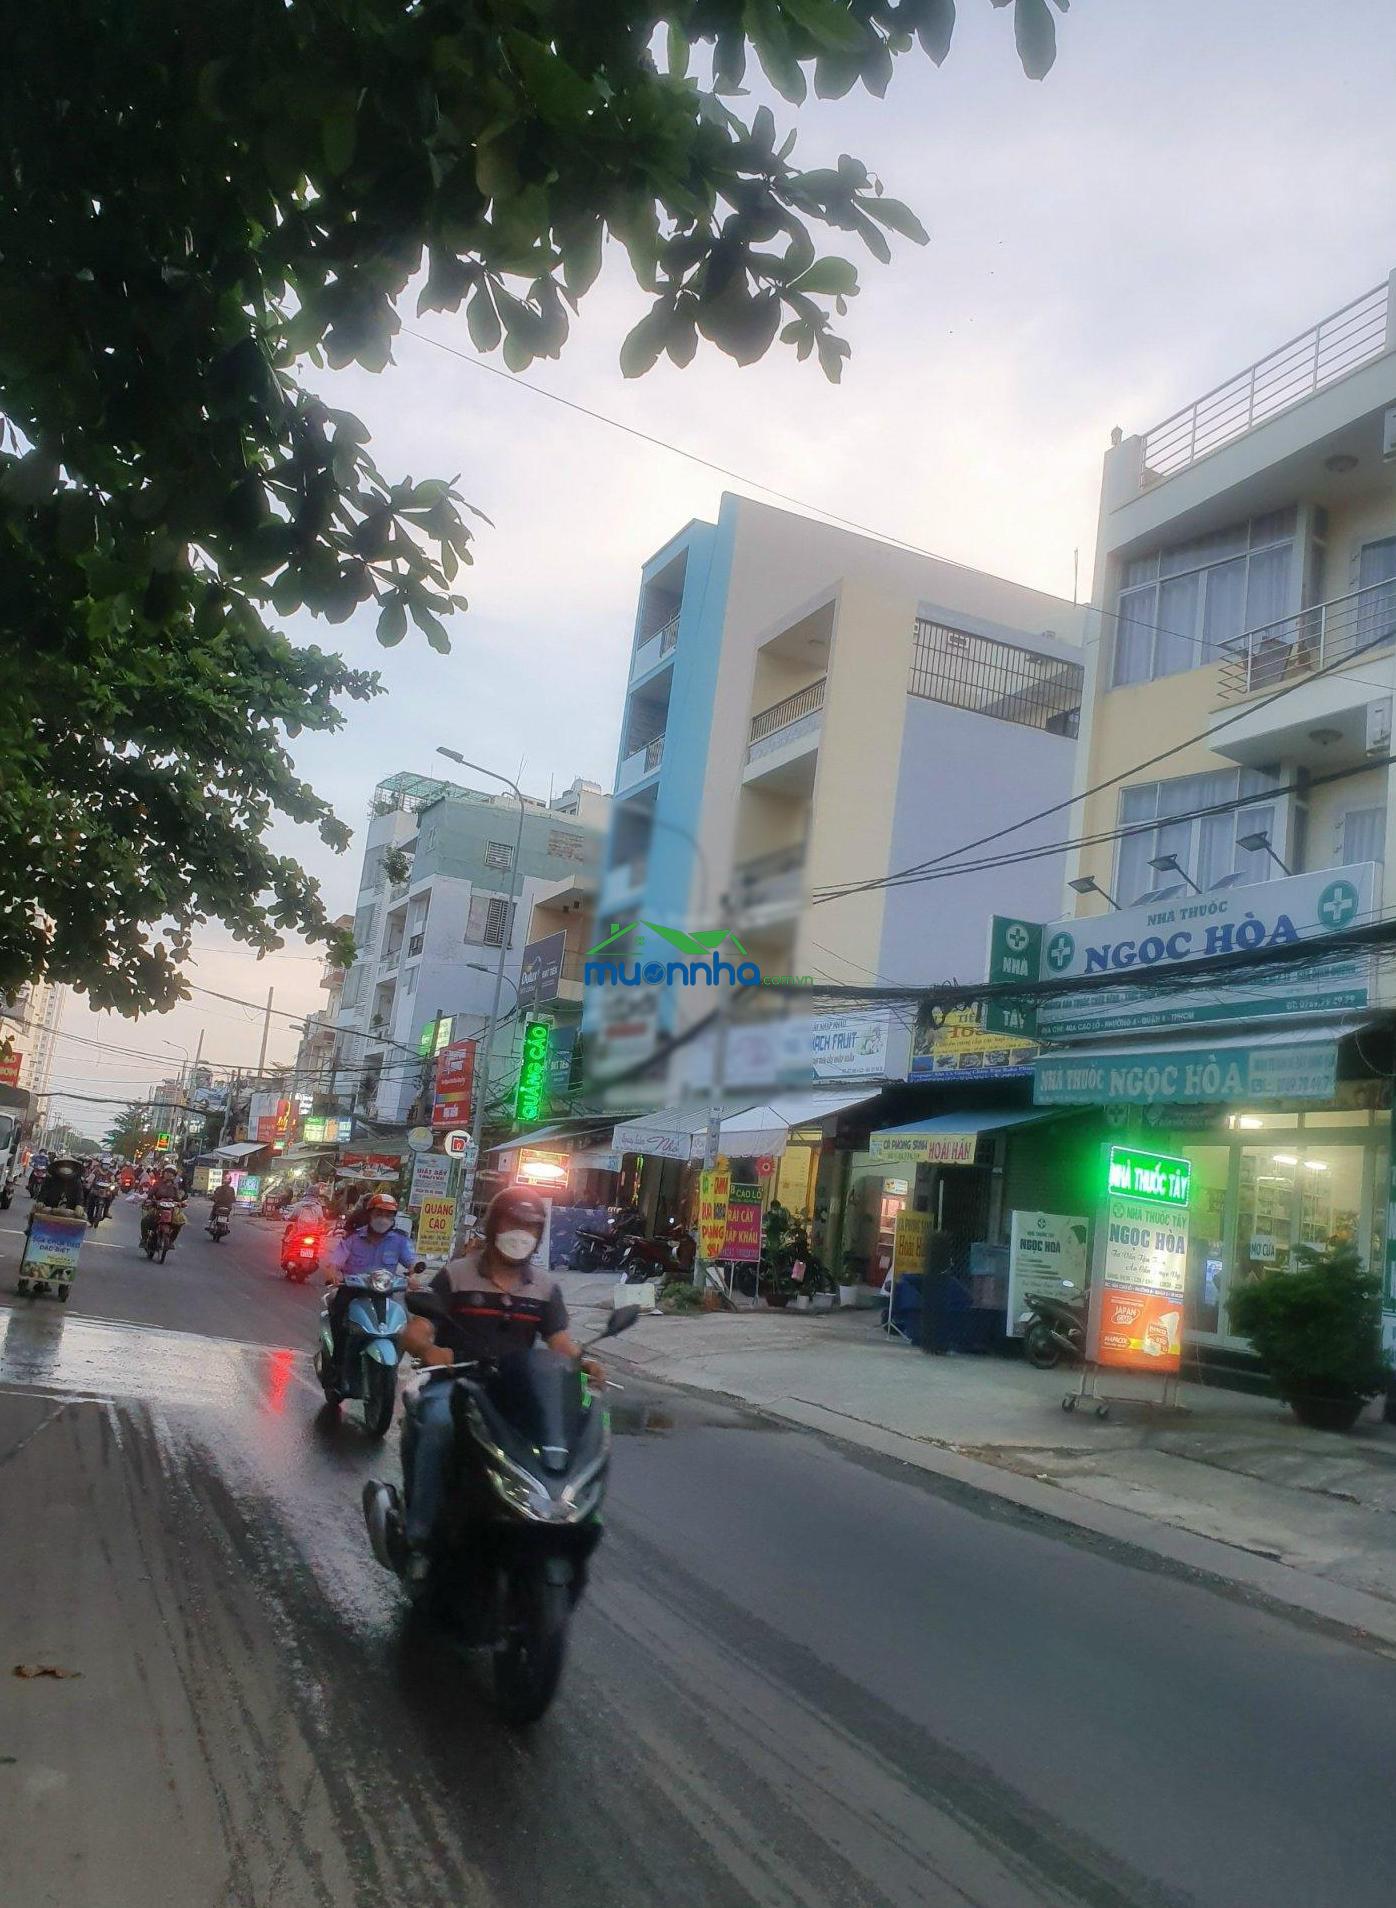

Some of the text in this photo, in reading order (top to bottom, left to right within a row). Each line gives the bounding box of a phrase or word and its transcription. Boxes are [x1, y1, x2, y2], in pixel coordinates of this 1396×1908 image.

[1147, 901, 1229, 926] NHÀ THUỐC
[1203, 912, 1300, 955] HÒA
[1108, 1065, 1179, 1101] NGỌC
[1184, 1054, 1242, 1096] HÒA
[1109, 1223, 1186, 1255] NGỌC HÒA
